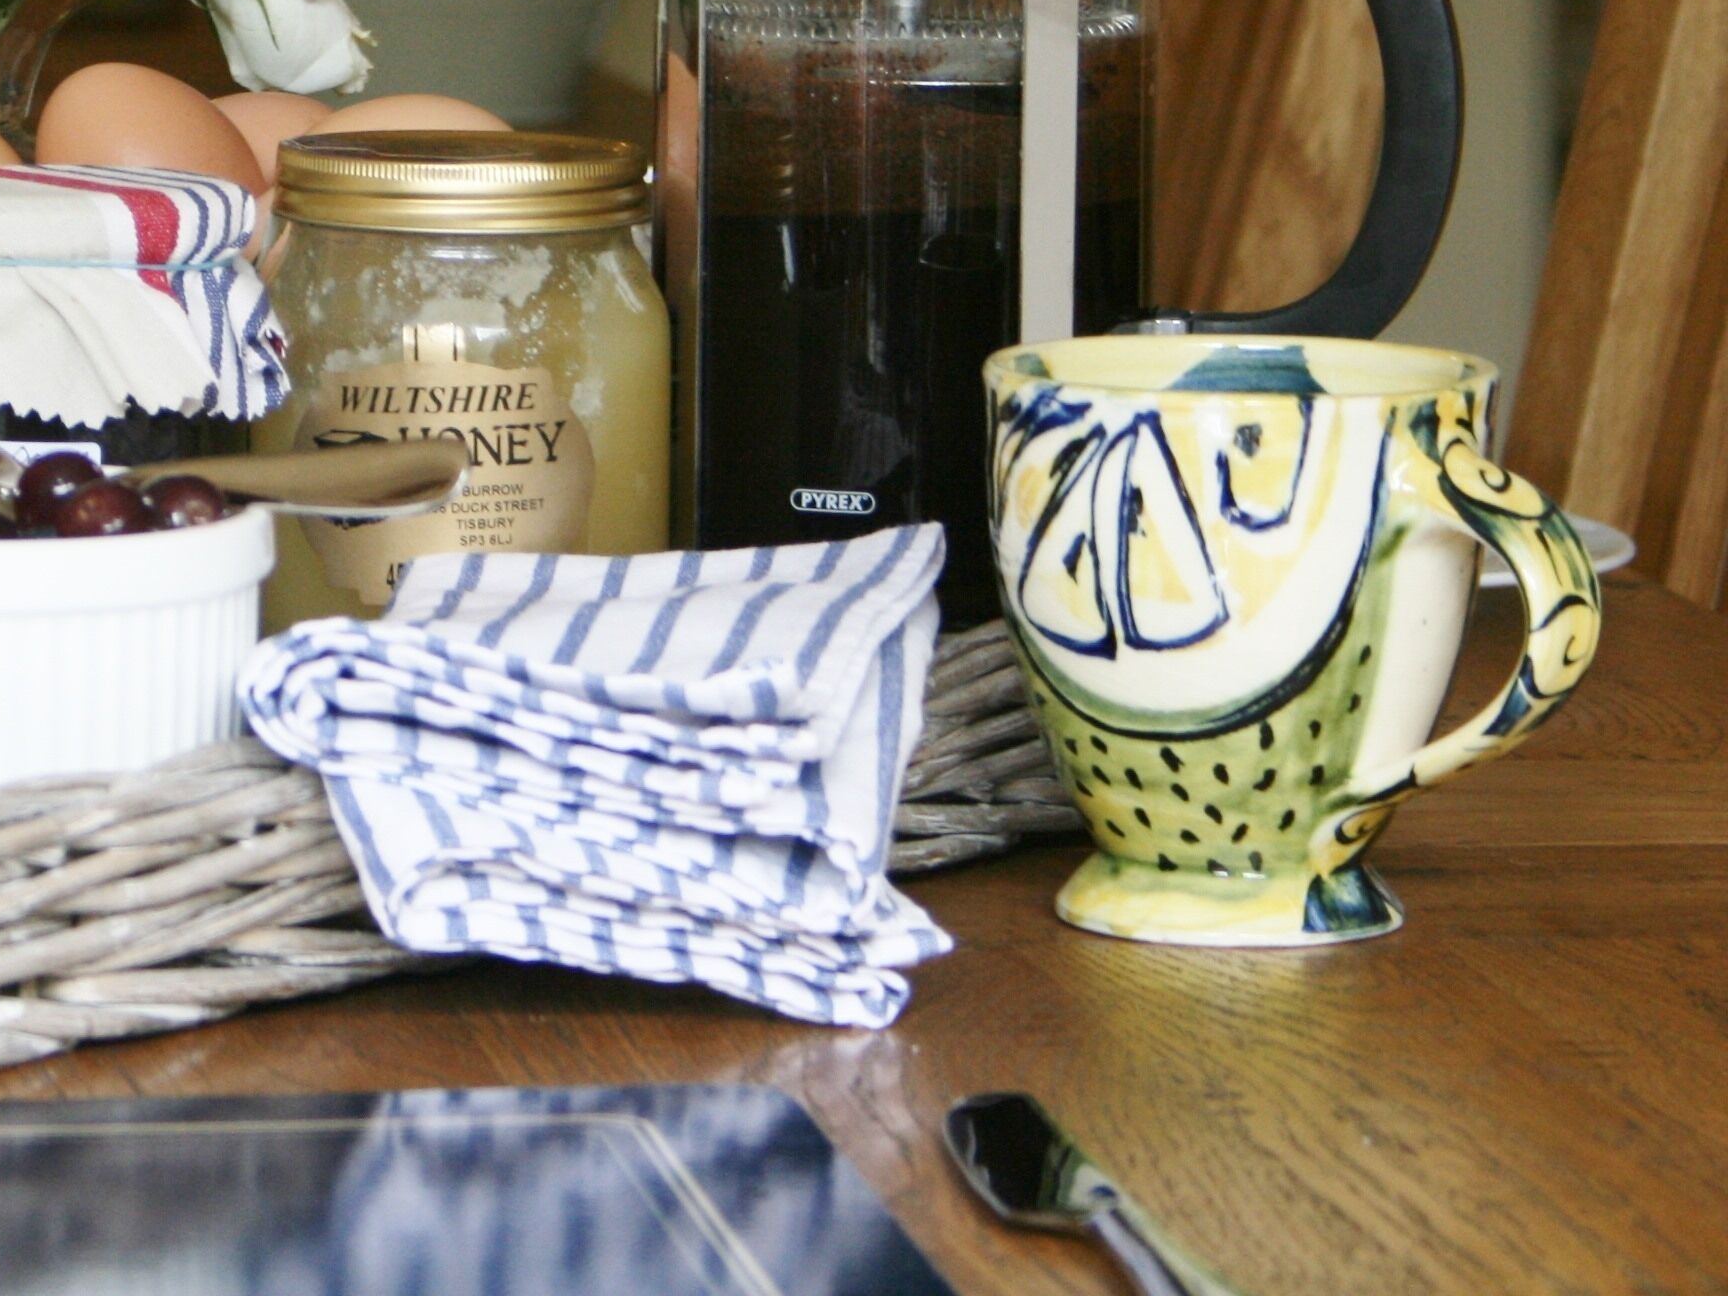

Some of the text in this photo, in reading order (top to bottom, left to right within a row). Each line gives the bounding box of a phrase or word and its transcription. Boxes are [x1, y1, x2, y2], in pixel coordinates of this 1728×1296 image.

[340, 382, 539, 413] WILTSHIRE
[462, 484, 524, 497] BURROW
[451, 502, 490, 514] DUCK
[494, 498, 545, 513] STREET
[800, 491, 863, 511] PYREX
[456, 517, 515, 530] TISBURY
[459, 535, 485, 546] SP3
